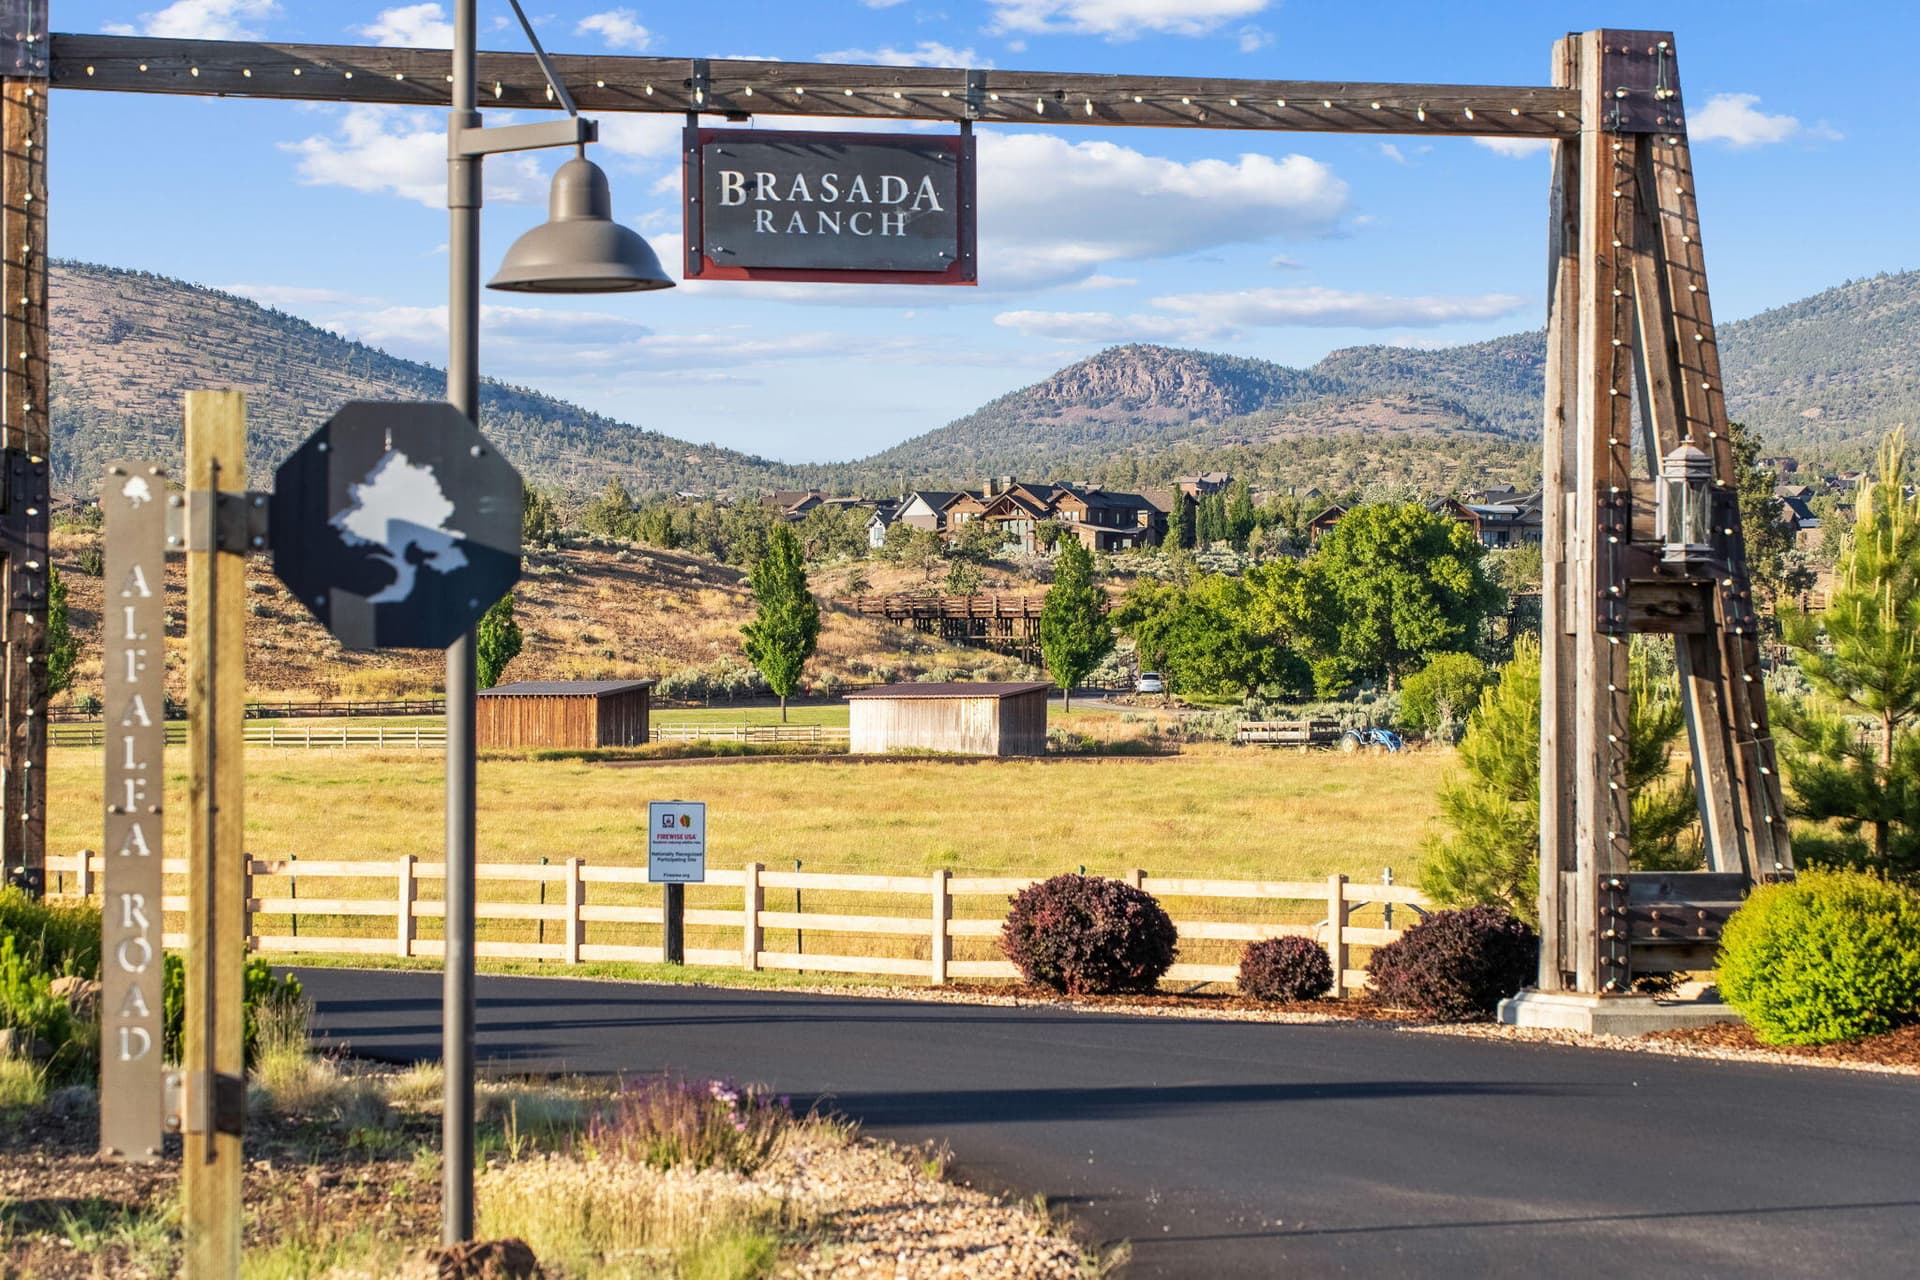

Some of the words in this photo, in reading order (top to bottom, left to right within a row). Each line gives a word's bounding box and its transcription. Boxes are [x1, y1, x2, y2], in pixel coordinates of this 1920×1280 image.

[718, 170, 945, 212] BRASADA
[755, 209, 907, 237] RANCH
[120, 564, 152, 857] ALFALFA
[117, 893, 153, 1062] ROAD
